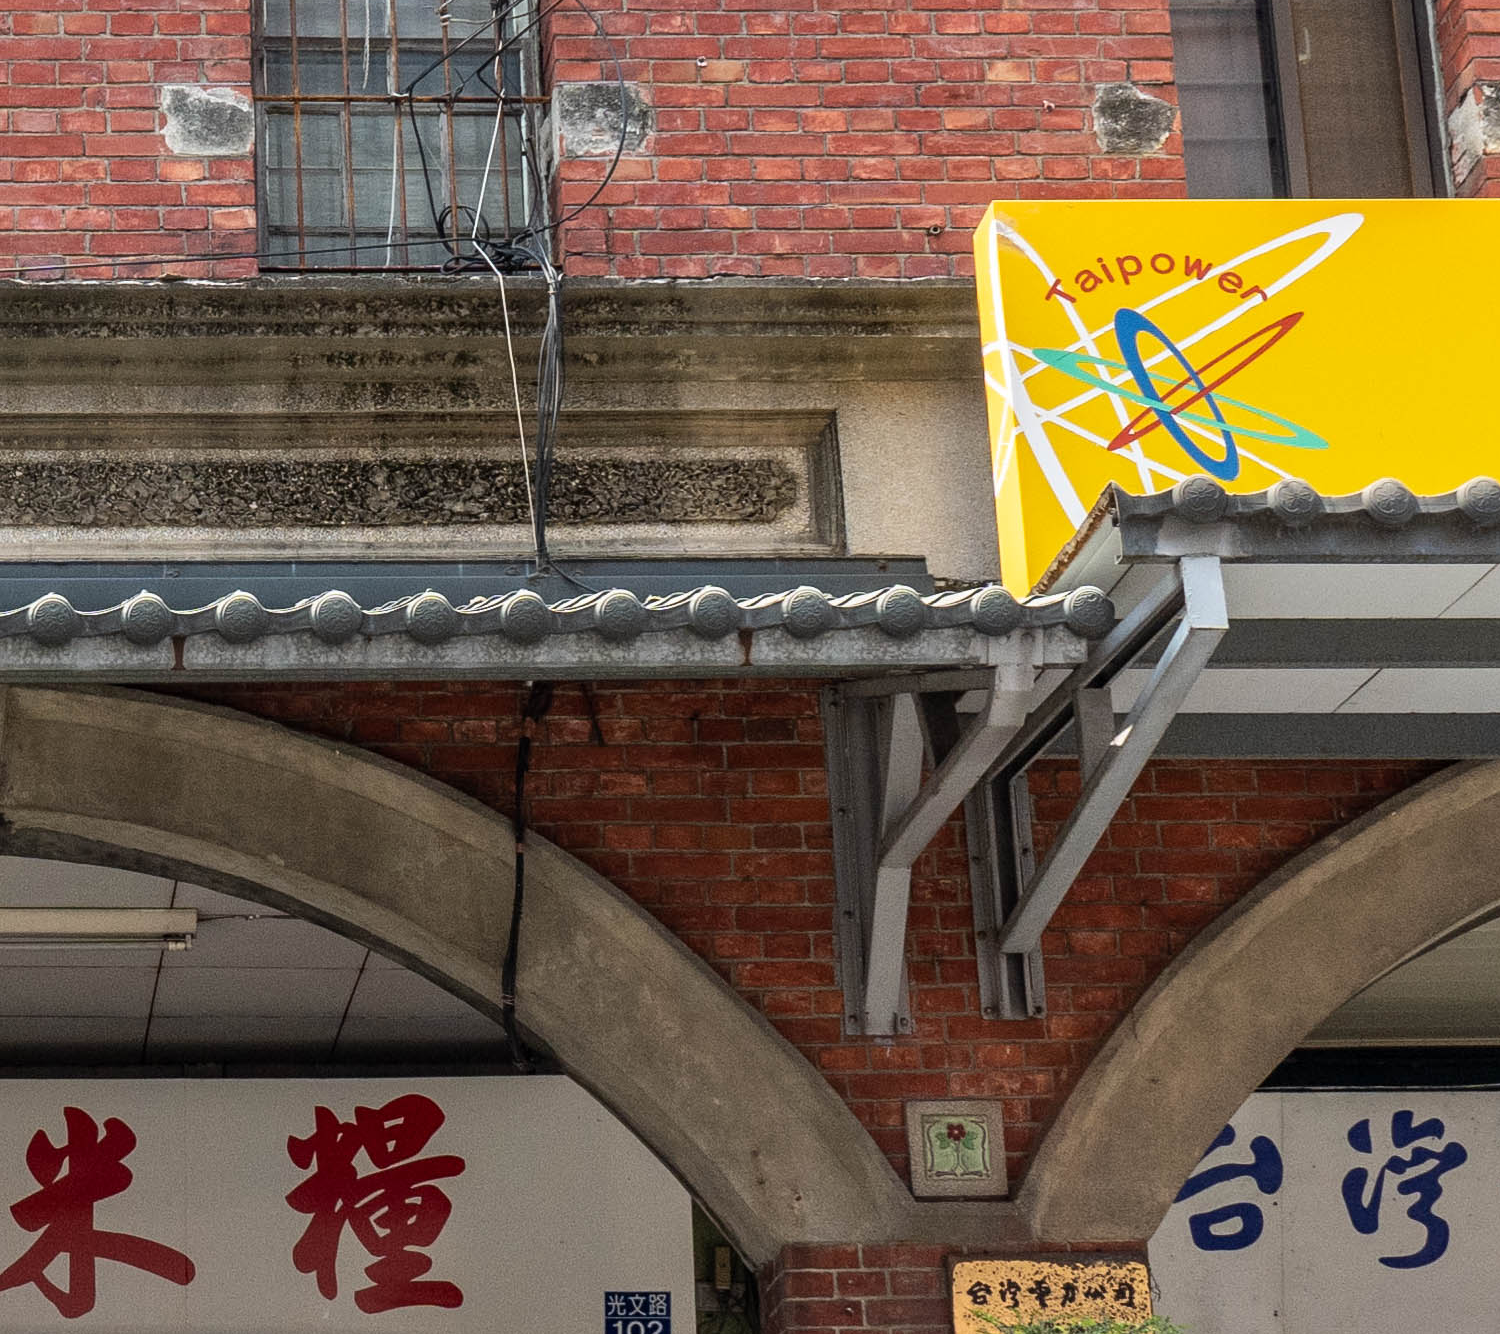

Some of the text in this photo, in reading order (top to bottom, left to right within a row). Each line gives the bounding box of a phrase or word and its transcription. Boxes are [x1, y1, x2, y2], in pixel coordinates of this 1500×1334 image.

[1045, 253, 1268, 304] Taipower
[608, 1293, 667, 1316] 光文路
